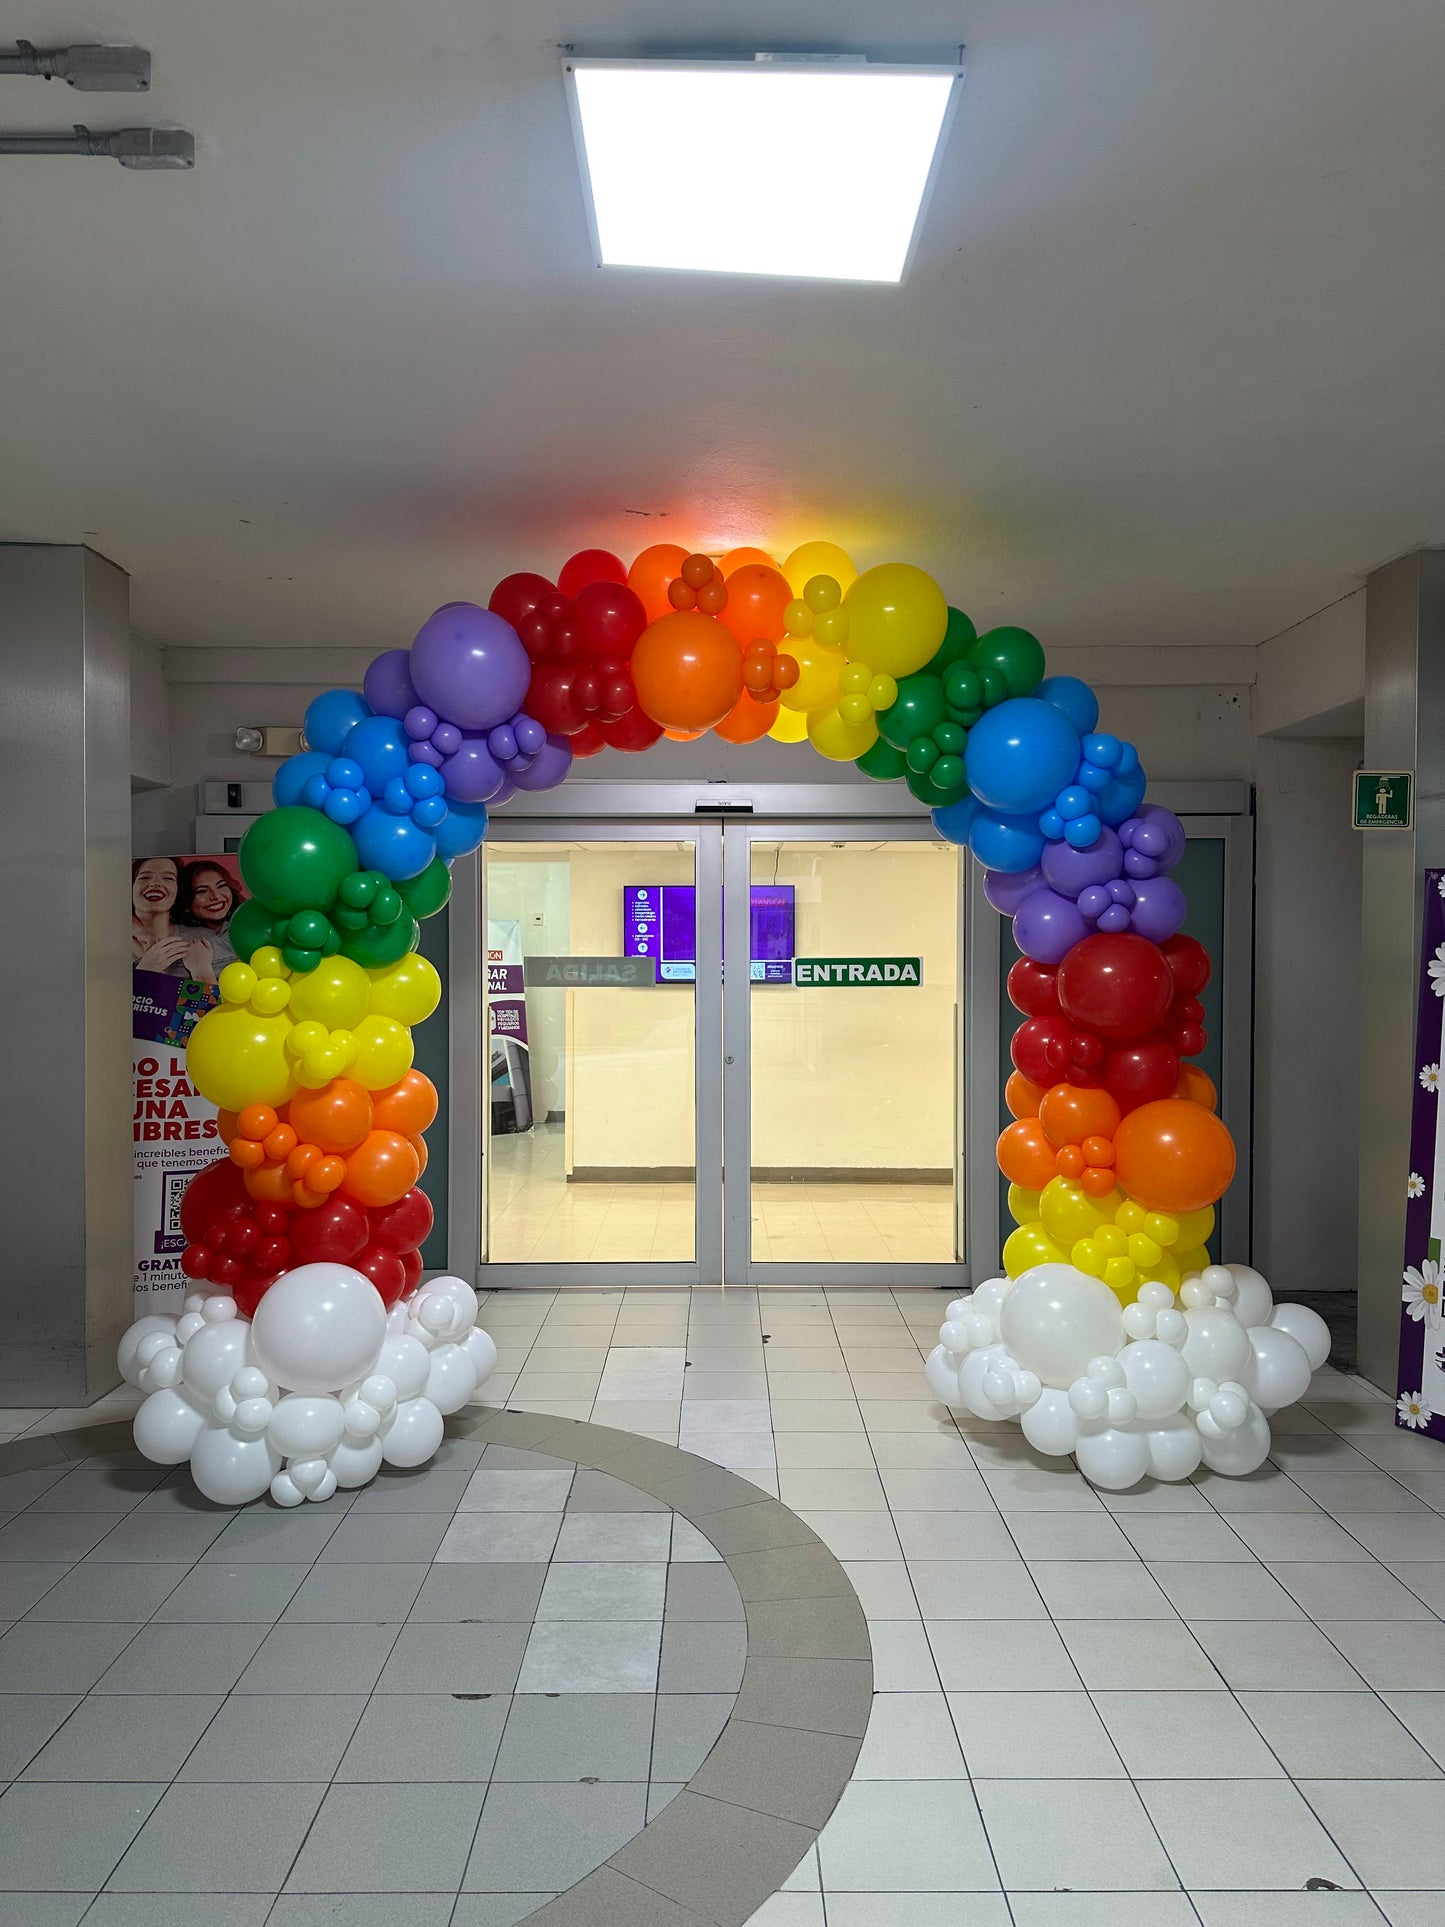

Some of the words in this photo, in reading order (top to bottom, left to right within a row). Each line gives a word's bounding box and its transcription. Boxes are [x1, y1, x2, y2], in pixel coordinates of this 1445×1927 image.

[797, 964, 918, 982] ENTRADA
[132, 1004, 168, 1017] RISTUS
[133, 1057, 159, 1076] O
[170, 1058, 189, 1076] L
[133, 1079, 201, 1098] ESA
[137, 1160, 158, 1170] que
[161, 1158, 209, 1167] tenemos
[143, 1272, 147, 1281] 1
